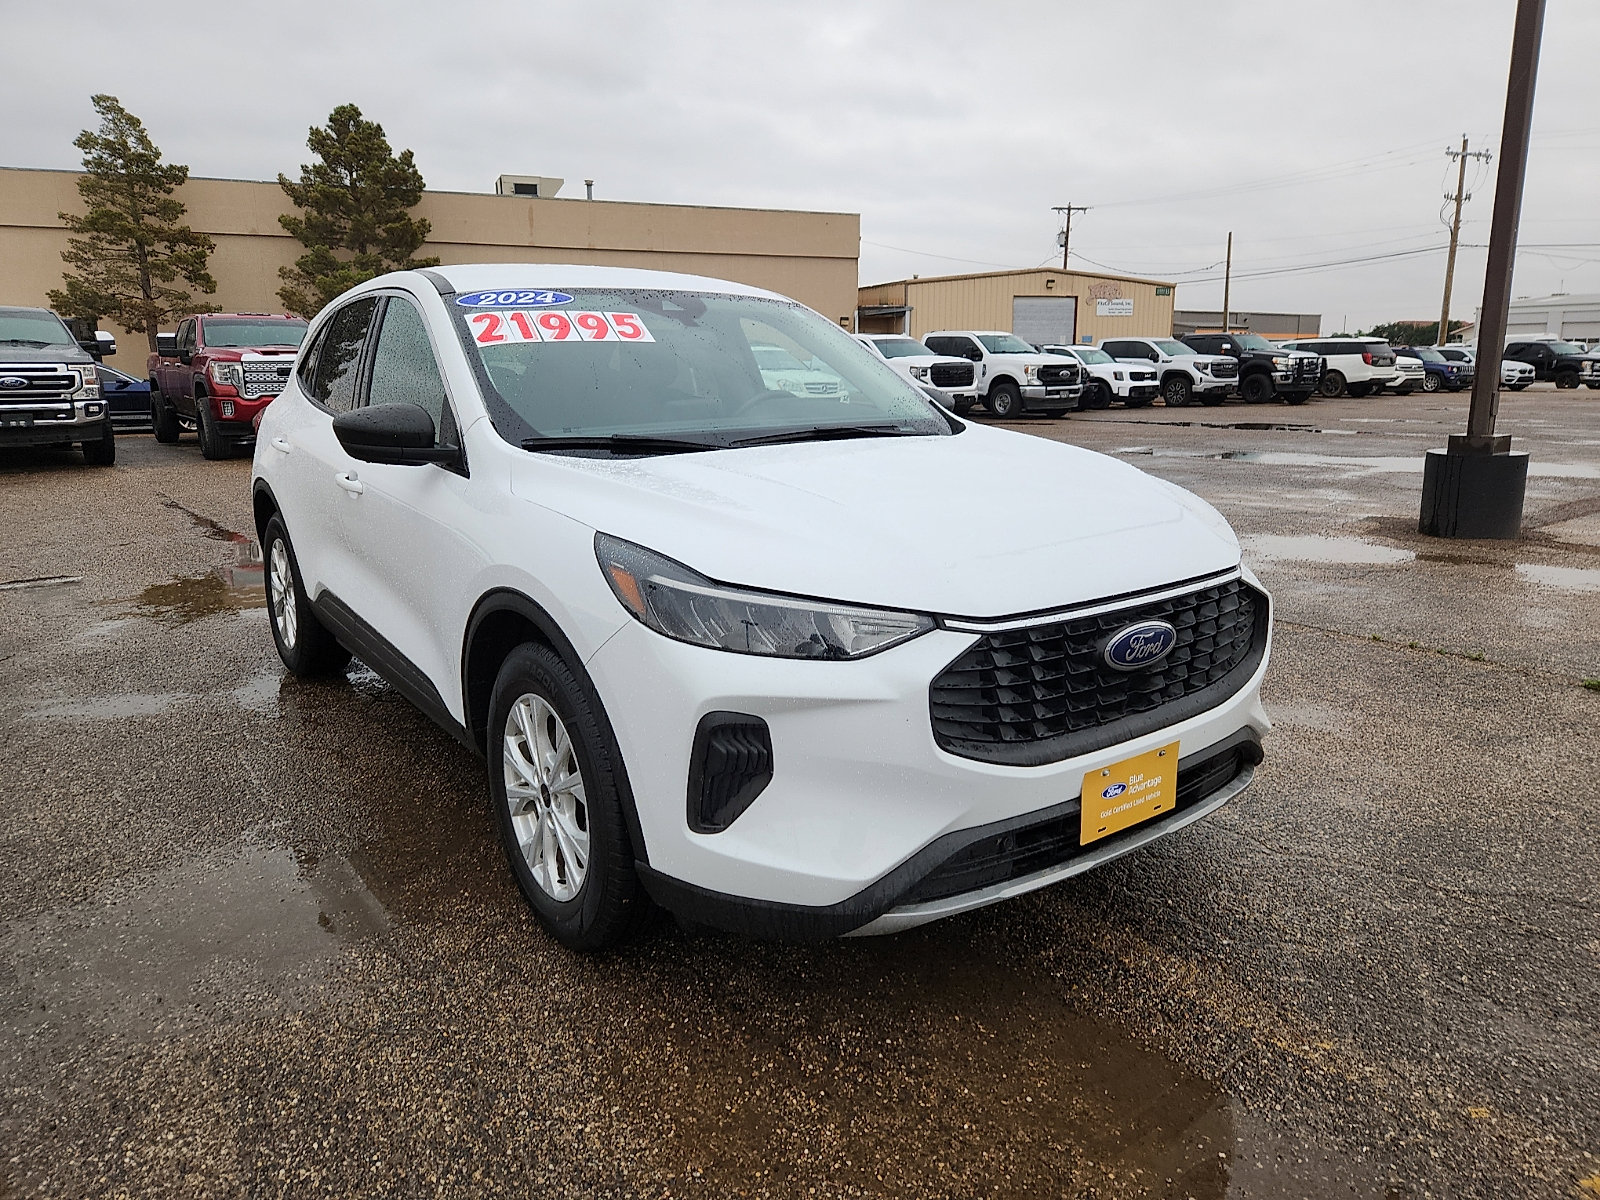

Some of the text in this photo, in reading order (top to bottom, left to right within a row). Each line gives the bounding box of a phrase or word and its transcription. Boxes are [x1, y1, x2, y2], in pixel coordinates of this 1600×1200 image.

[478, 291, 556, 306] 2024
[471, 312, 646, 343] 21995
[1126, 632, 1164, 661] Ford
[1128, 776, 1162, 795] Advantage
[1129, 774, 1144, 785] Blue
[1101, 809, 1113, 819] Gold
[1113, 802, 1133, 814] Certified
[1133, 796, 1146, 806] Used
